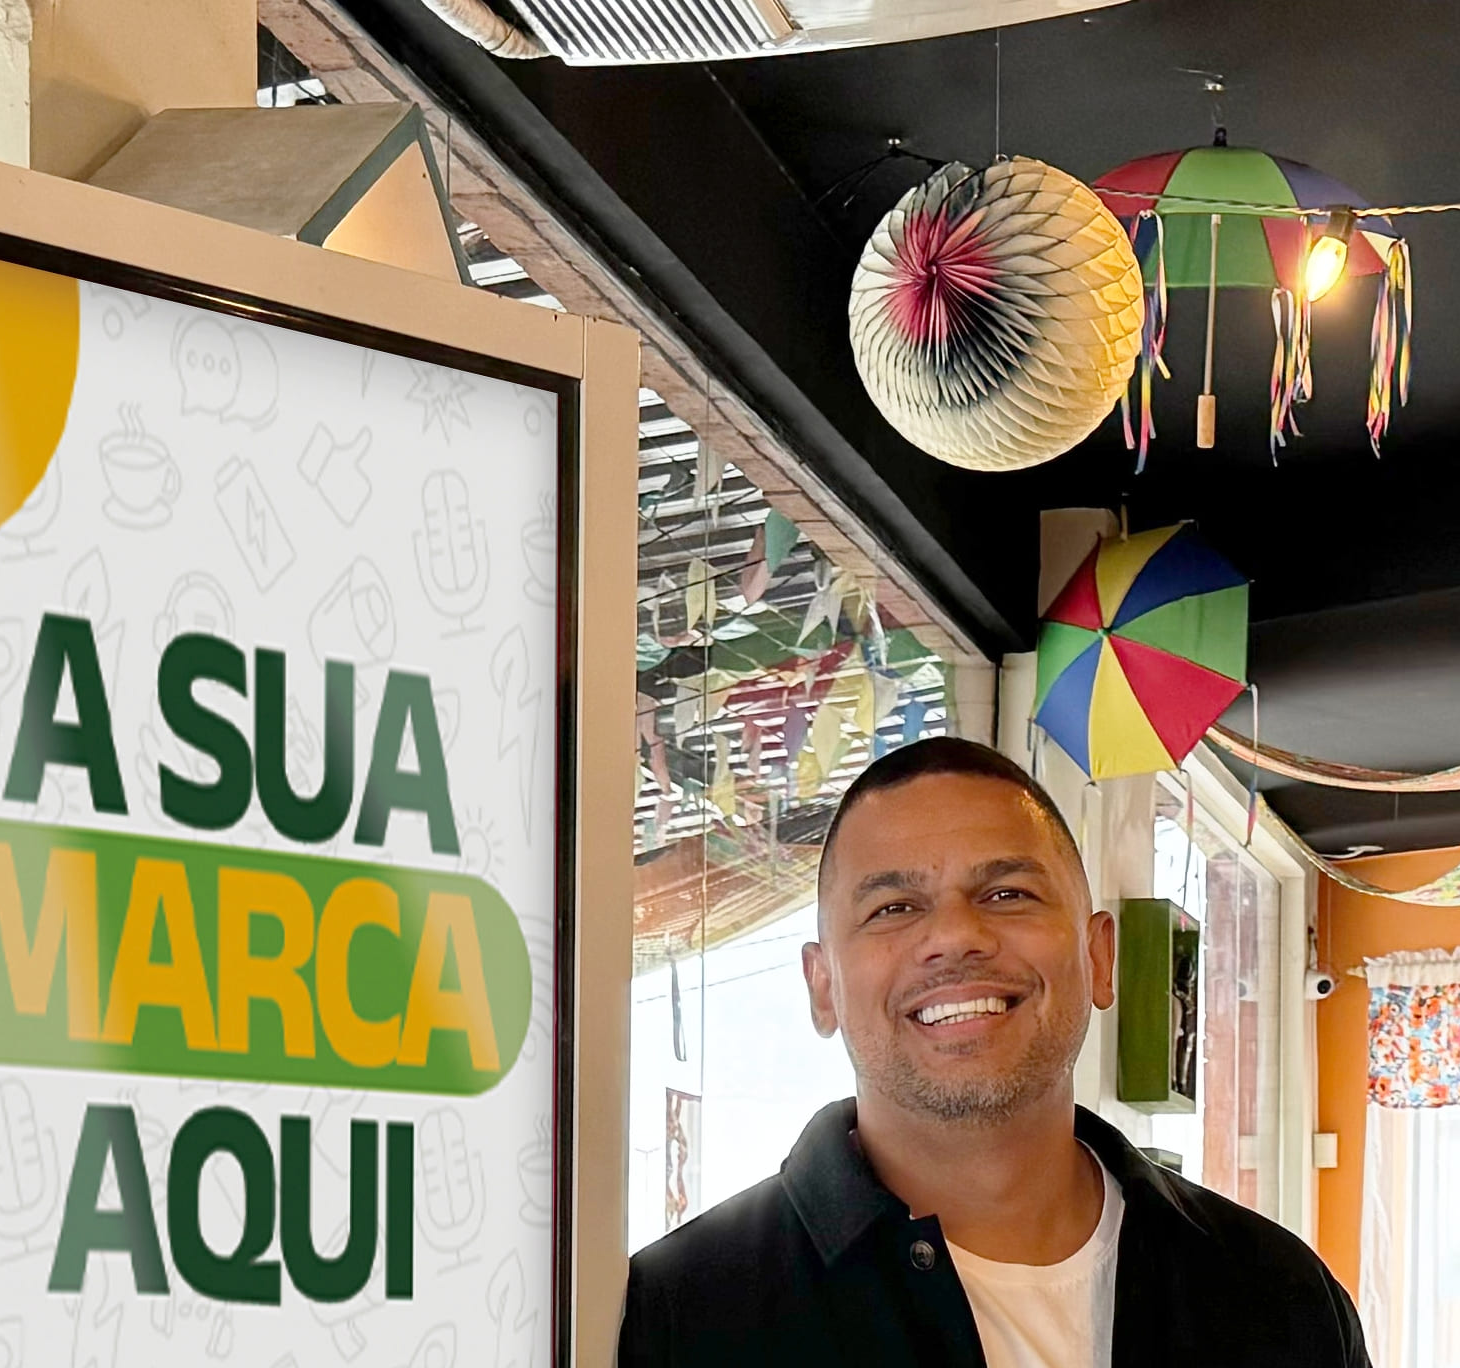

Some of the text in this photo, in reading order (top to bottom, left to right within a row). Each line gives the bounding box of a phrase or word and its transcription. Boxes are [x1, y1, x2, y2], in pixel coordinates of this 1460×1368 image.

[2, 612, 461, 856] A SUA
[47, 1101, 415, 1307] AQUI
